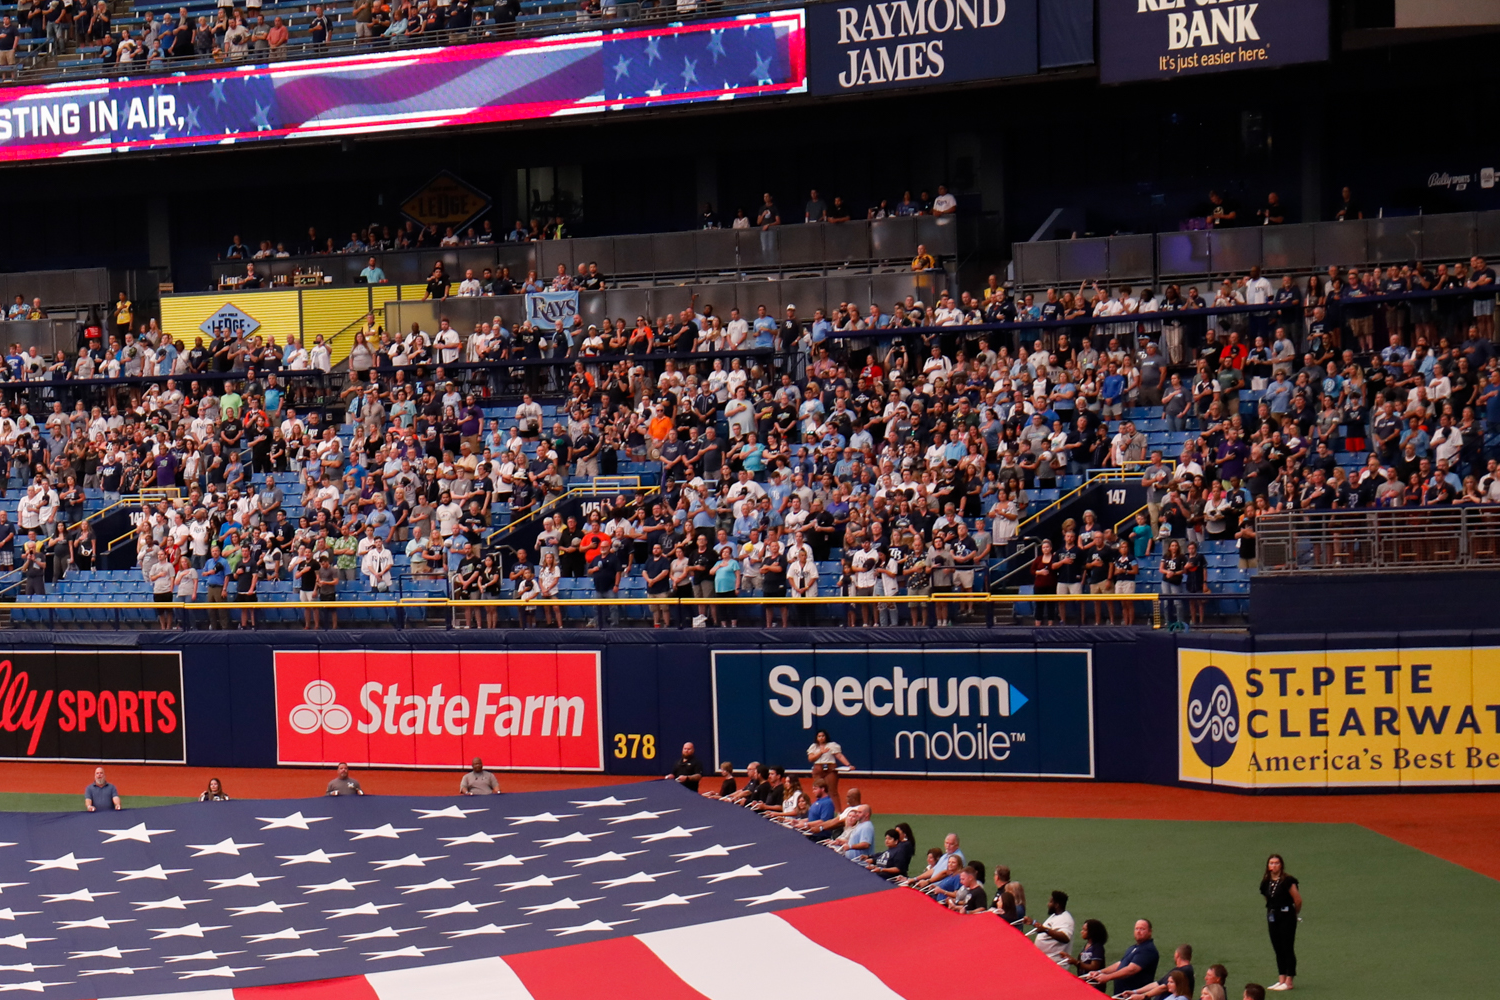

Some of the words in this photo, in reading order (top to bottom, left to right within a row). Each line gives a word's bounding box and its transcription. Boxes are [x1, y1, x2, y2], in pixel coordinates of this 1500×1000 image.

[837, 0, 1007, 44] RAYMOND
[1168, 4, 1261, 50] BANK
[839, 40, 945, 88] JAMES
[1159, 55, 1175, 71] It's
[1177, 52, 1199, 73] just
[1201, 49, 1236, 66] easier
[89, 99, 119, 132] IN
[127, 94, 185, 132] AIR,
[418, 194, 469, 218] LEDGE
[531, 296, 576, 324] RAYS
[580, 502, 600, 517] 145
[1106, 489, 1126, 505] 147
[58, 688, 177, 734] SPORTS
[769, 665, 1011, 729] Spectrum
[613, 733, 656, 760] 378
[1249, 747, 1383, 772] America's
[1393, 747, 1456, 769] Best
